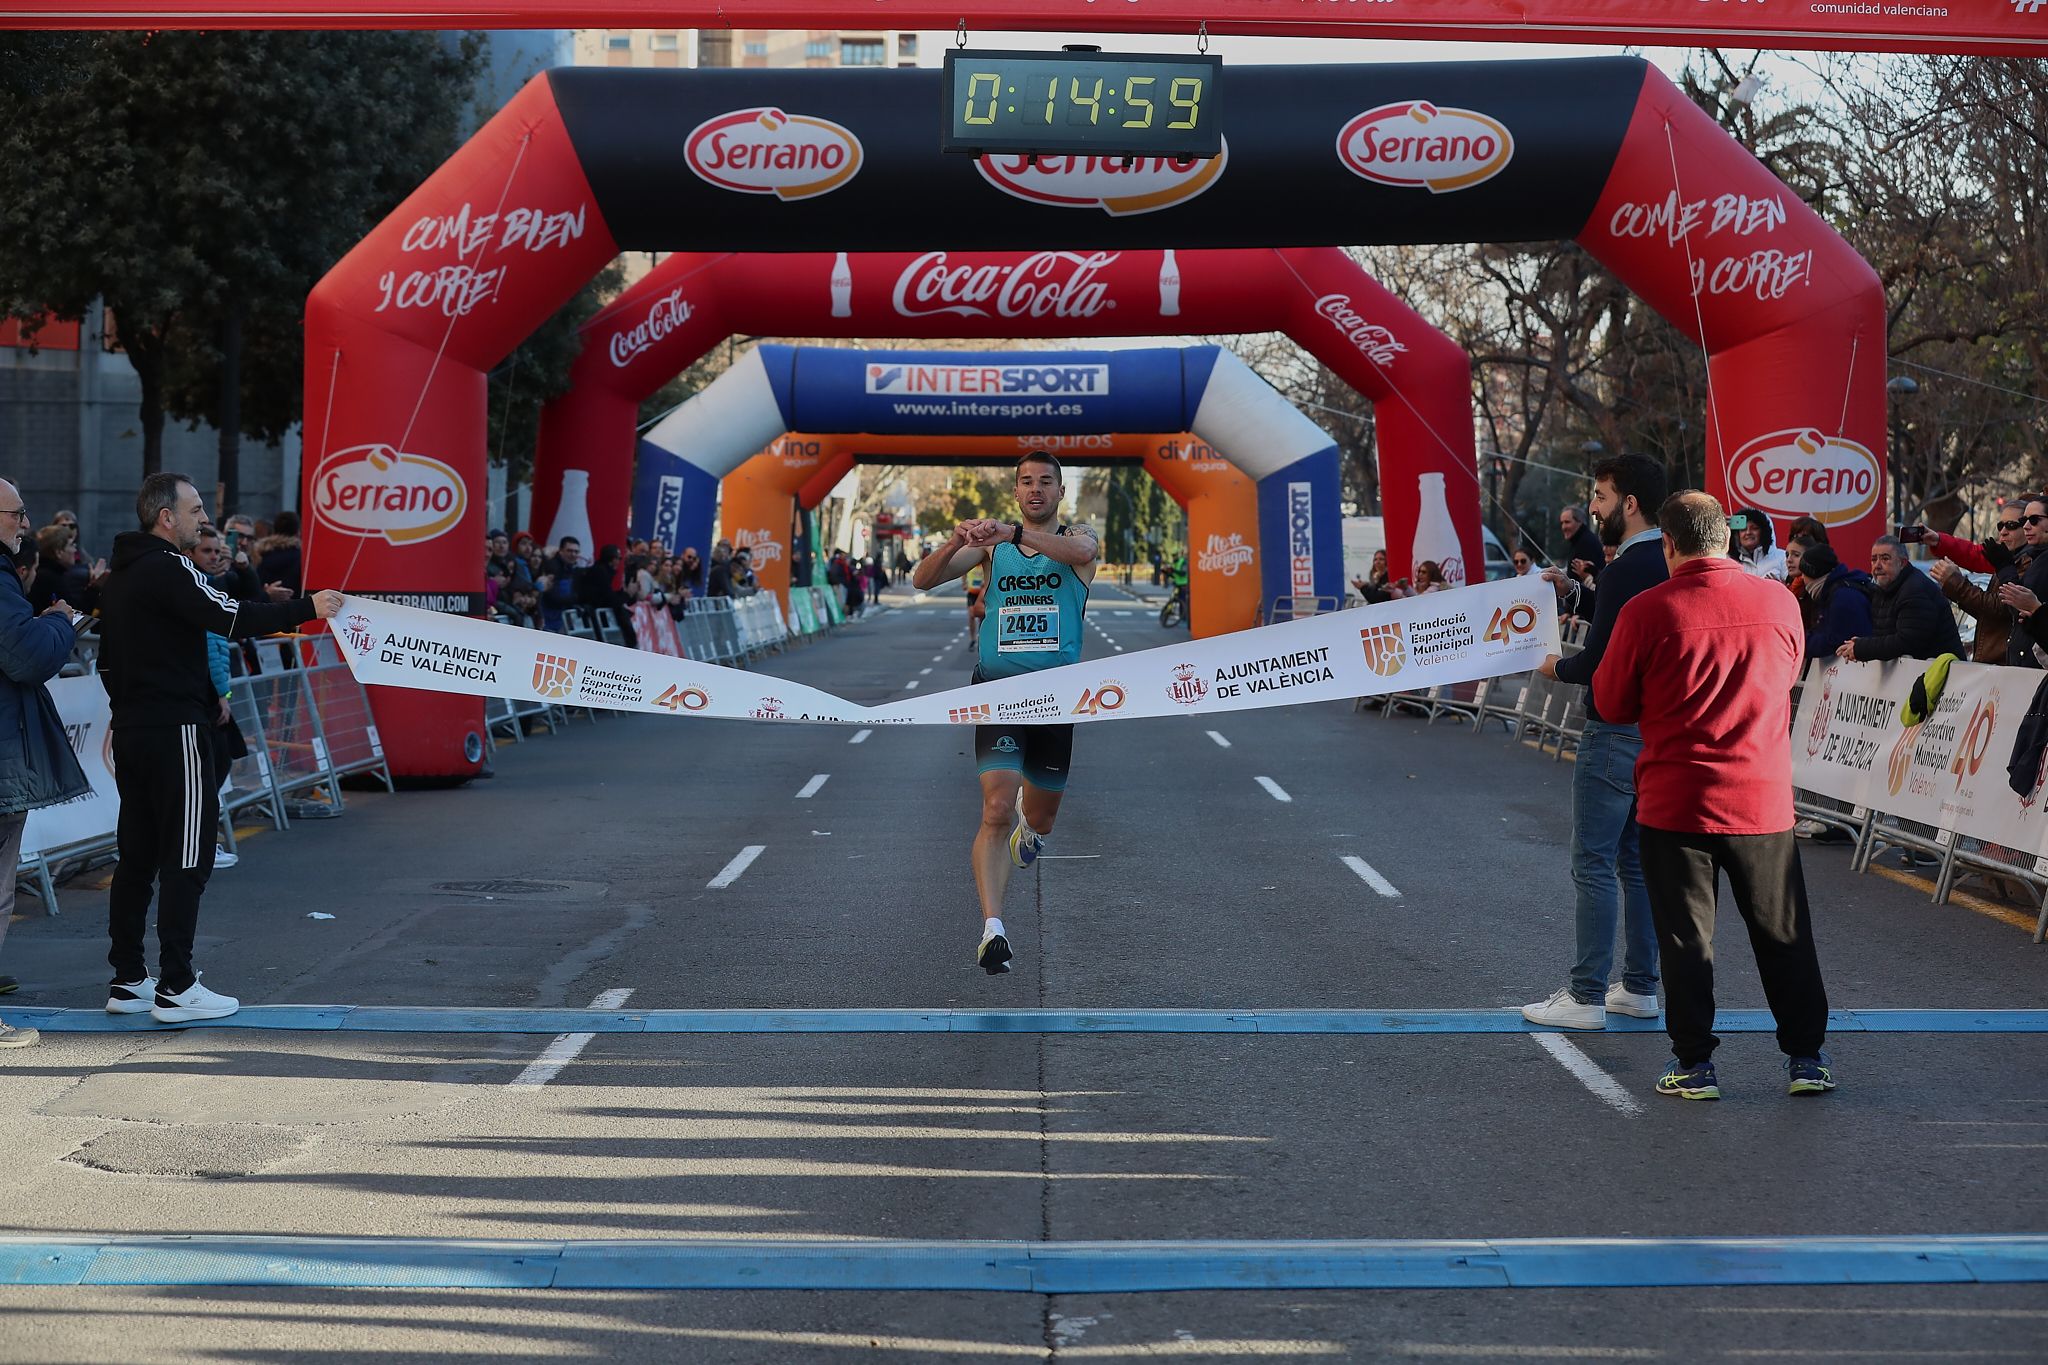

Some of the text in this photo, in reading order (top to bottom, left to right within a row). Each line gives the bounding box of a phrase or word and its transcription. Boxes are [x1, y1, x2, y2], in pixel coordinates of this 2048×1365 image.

[1810, 2, 1948, 17] comunidad valenciana
[704, 133, 844, 170] Serrano
[1356, 126, 1495, 163] Serrano
[402, 202, 586, 260] COME BIEN
[1610, 190, 1786, 248] COME BIEN
[907, 367, 1100, 392] INTERSPORT
[893, 402, 1083, 418] www.intersport.es
[1017, 434, 1113, 450] seguros
[1743, 456, 1872, 496] Serrano
[320, 472, 453, 512] Serrano
[998, 573, 1062, 592] CRESPO
[1005, 595, 1054, 606] RUNNERS
[1007, 615, 1048, 633] 2425
[1409, 612, 1467, 632] Fundació
[1411, 626, 1471, 644] Esportiva
[1483, 604, 1537, 646] 40
[384, 633, 502, 667] AJUNTAMENT
[1413, 635, 1474, 656] Municipal
[380, 650, 497, 683] DE VALÈNCIA
[1215, 647, 1329, 682] AJUNTAMENT
[1414, 651, 1468, 668] València
[581, 676, 642, 695] Esportiva
[583, 665, 642, 685] Fundació
[1217, 667, 1334, 699] DE VALÈNCIA
[580, 686, 643, 703] Municipal
[651, 683, 709, 710] 40
[998, 693, 1055, 711] Fundació
[1071, 685, 1126, 716] 40
[1834, 691, 1896, 731] AJUNTAMENT
[1822, 731, 1881, 770] DE VALÈNCIA
